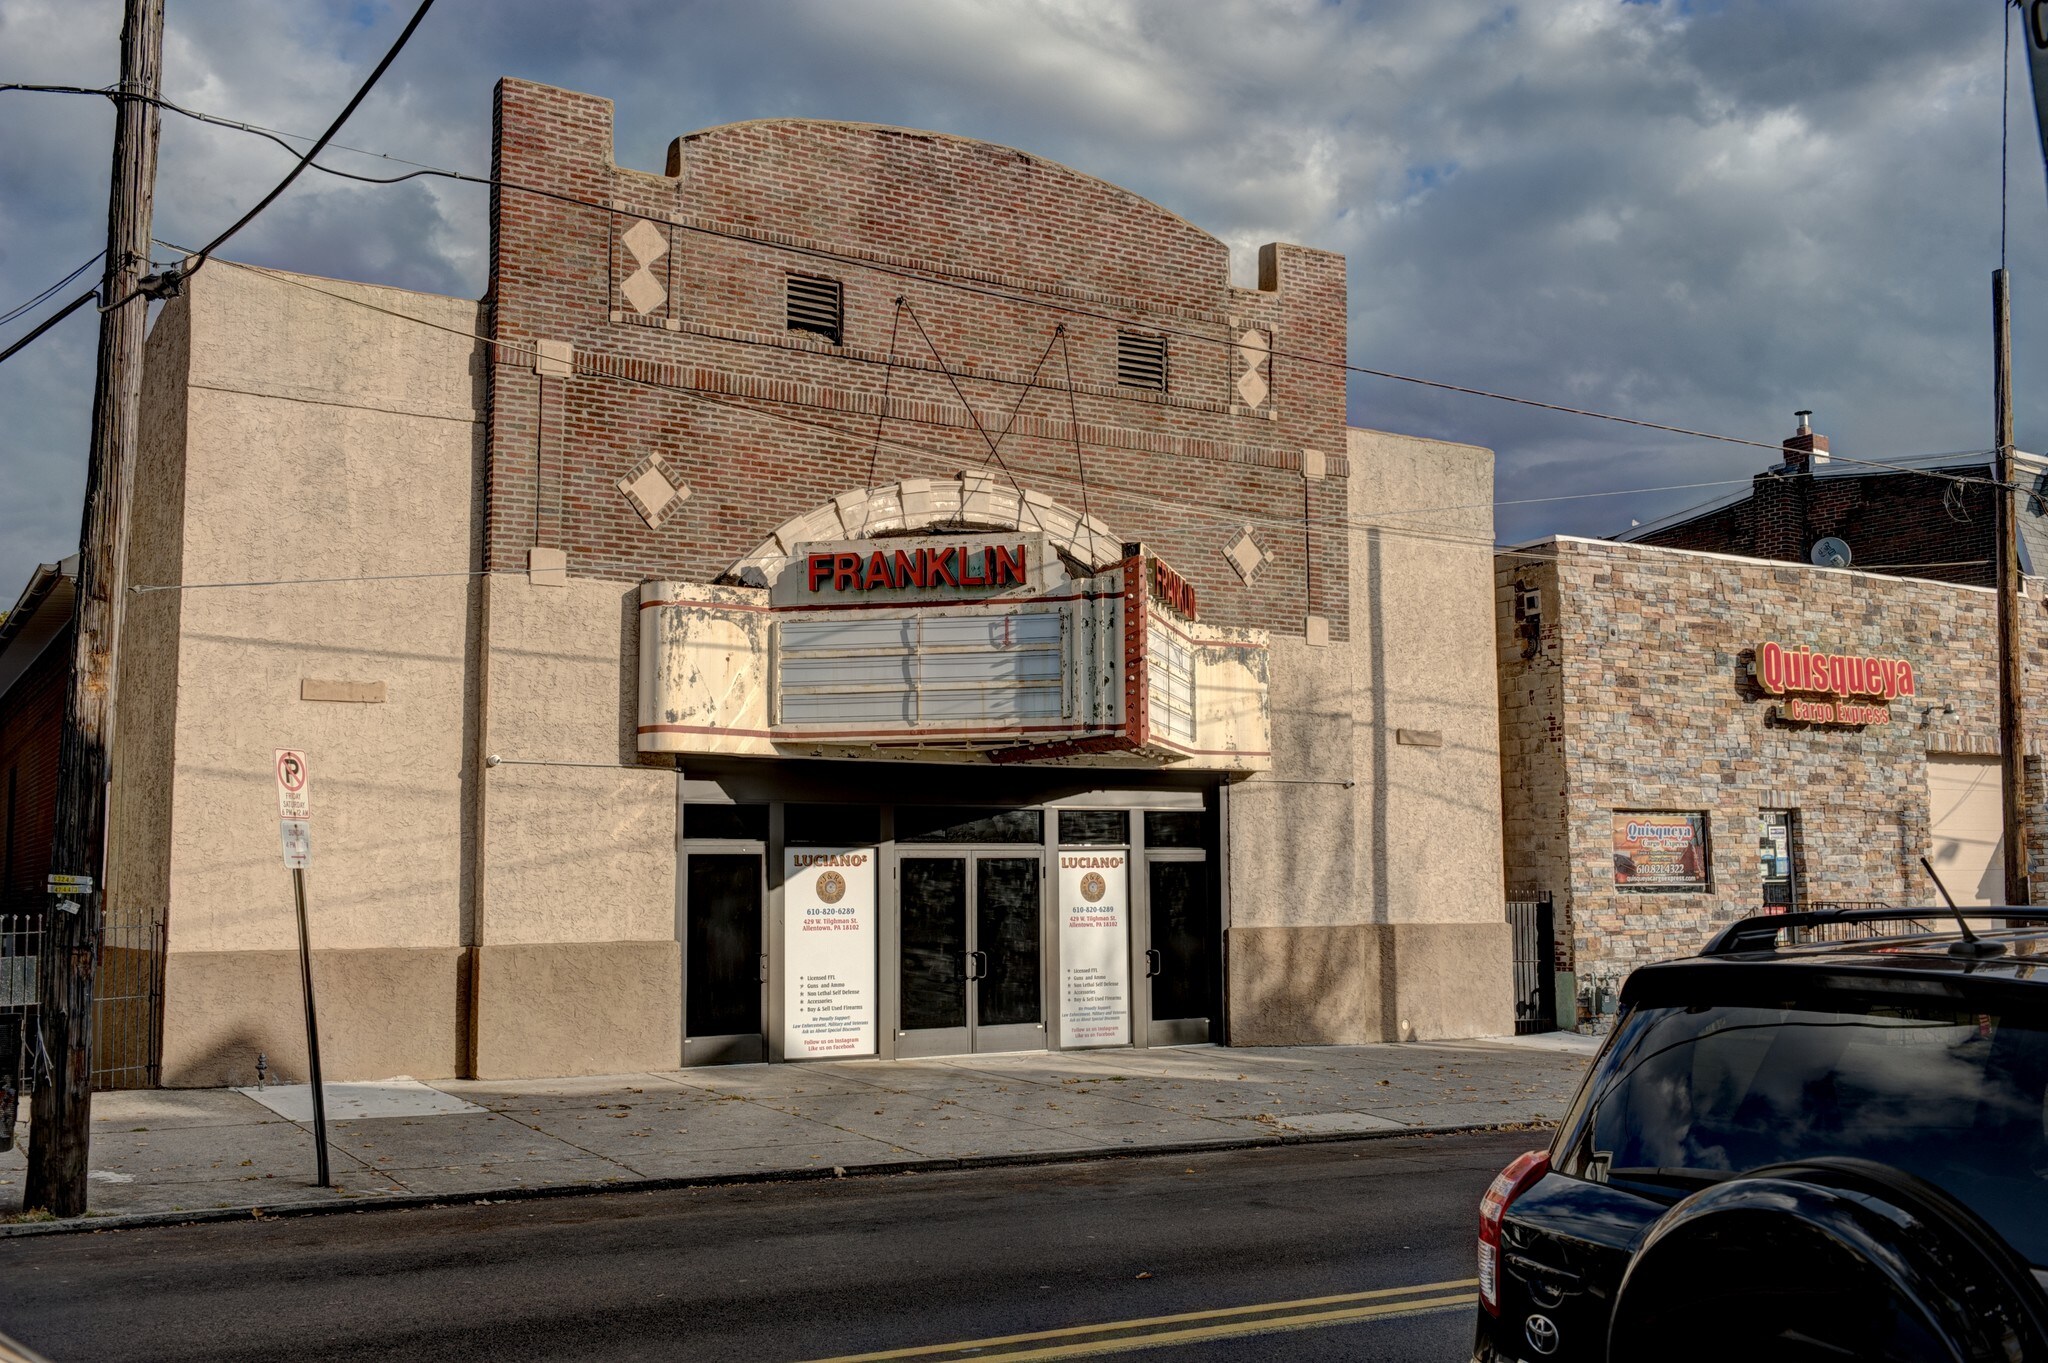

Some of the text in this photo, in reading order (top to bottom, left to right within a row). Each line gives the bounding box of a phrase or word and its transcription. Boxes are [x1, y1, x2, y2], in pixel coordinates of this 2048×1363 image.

[808, 544, 1026, 592] FRANKLIN
[1156, 559, 1196, 620] FRANKLIN
[1763, 641, 1915, 700] Quisqueya
[1792, 698, 1889, 725] Cargo Express
[283, 800, 305, 808] SATURDAY
[1628, 822, 1691, 840] Quisqueya
[1642, 839, 1689, 848] Cargo Express
[1636, 864, 1684, 873] 610.821.4322
